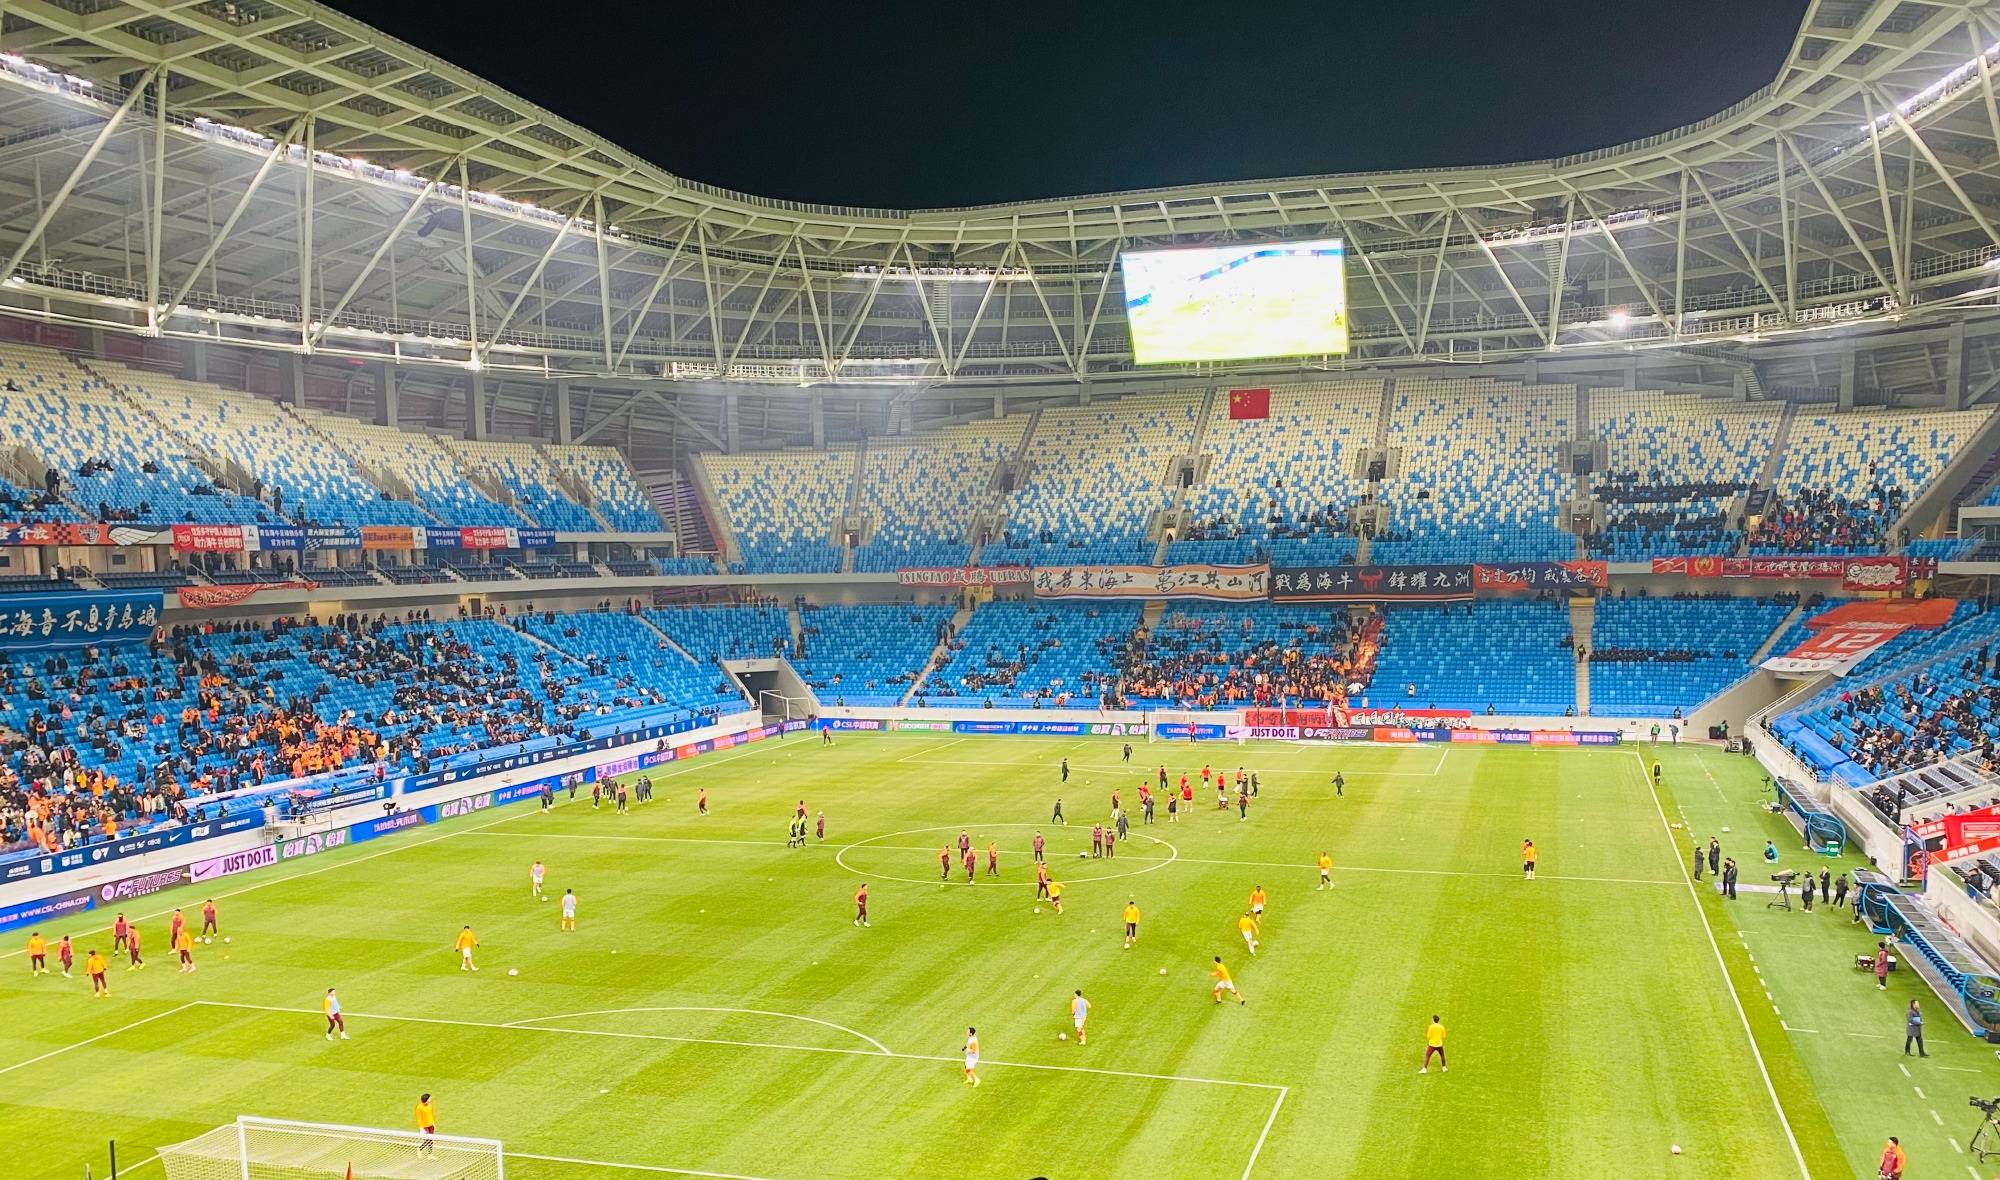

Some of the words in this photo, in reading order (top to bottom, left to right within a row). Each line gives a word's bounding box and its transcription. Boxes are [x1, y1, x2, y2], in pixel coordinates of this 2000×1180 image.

[1816, 632, 1884, 649] 12
[1250, 728, 1272, 738] JUST
[1272, 728, 1286, 737] DO
[1286, 728, 1297, 738] IT.
[222, 854, 247, 874] JUST
[247, 850, 262, 867] DO
[261, 847, 274, 863] IT.
[20, 895, 90, 919] WWW.CSL-CHINA.COM
